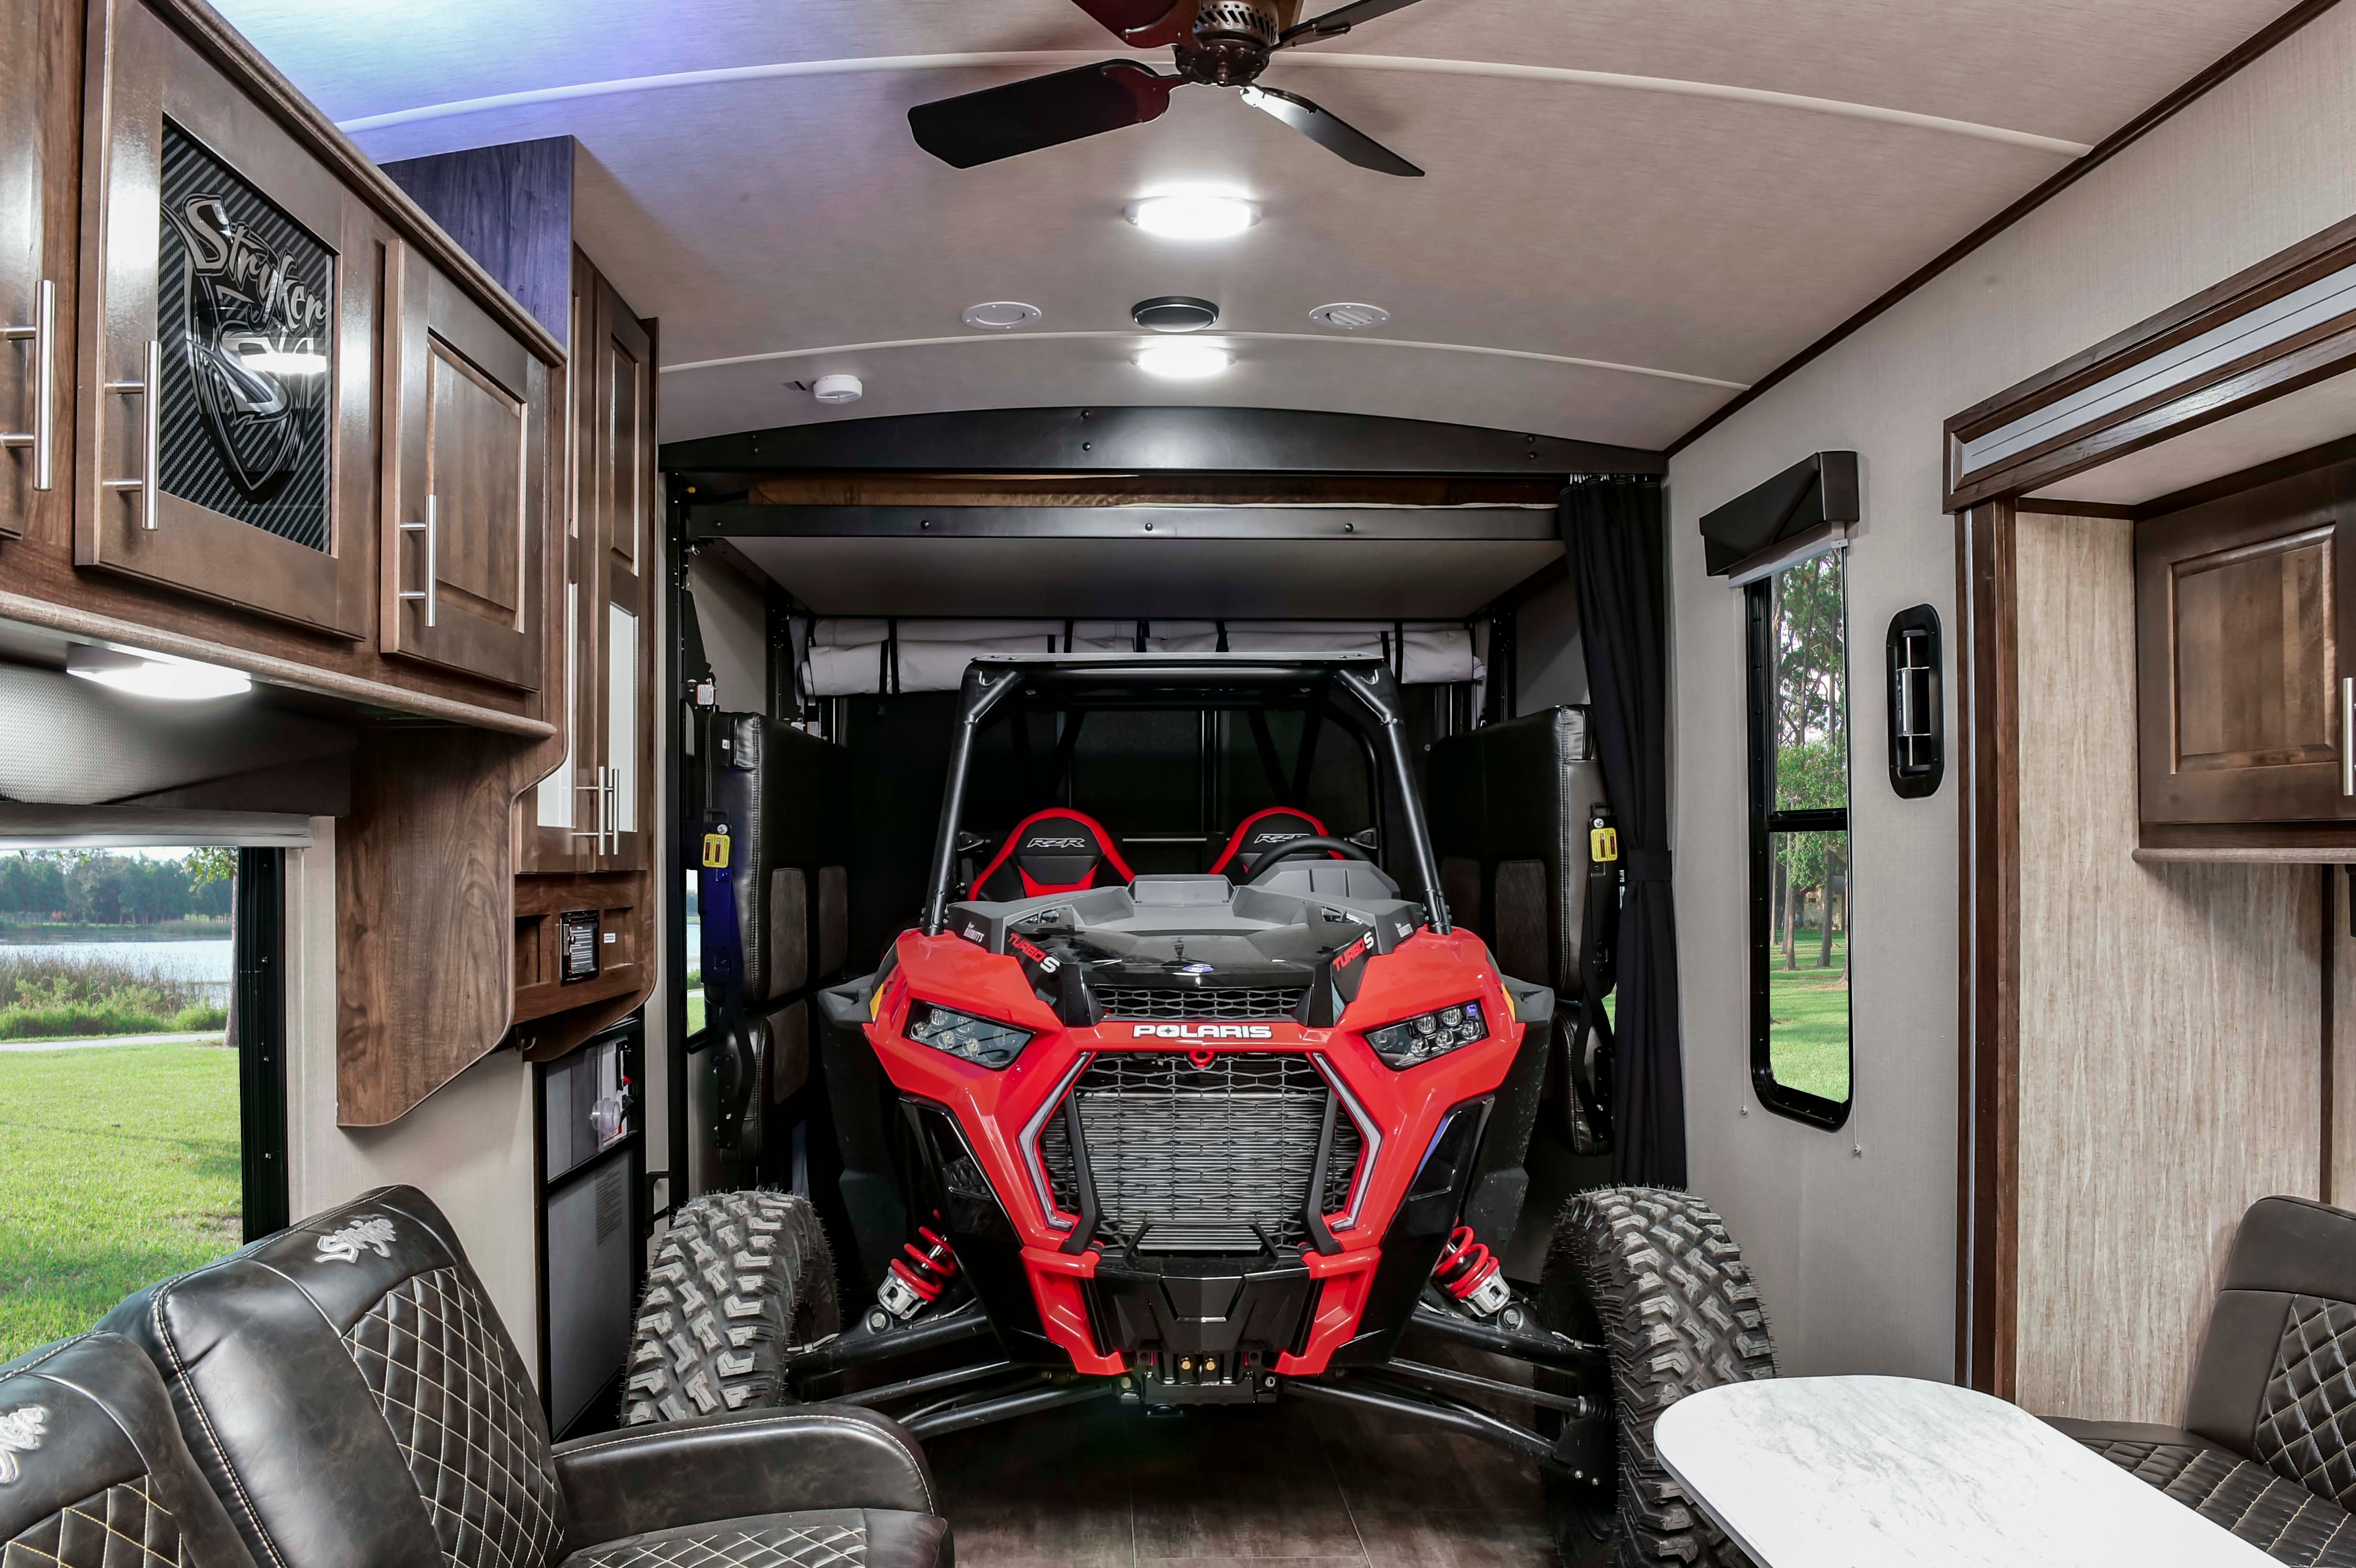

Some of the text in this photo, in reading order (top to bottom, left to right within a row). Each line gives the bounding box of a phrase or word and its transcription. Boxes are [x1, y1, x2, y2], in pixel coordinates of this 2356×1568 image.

[161, 193, 327, 336] Stryker
[1026, 838, 1085, 848] RZR
[1008, 933, 1060, 973] TURBO S
[1332, 931, 1374, 971] TURBO S
[1133, 1024, 1273, 1038] POLARIS
